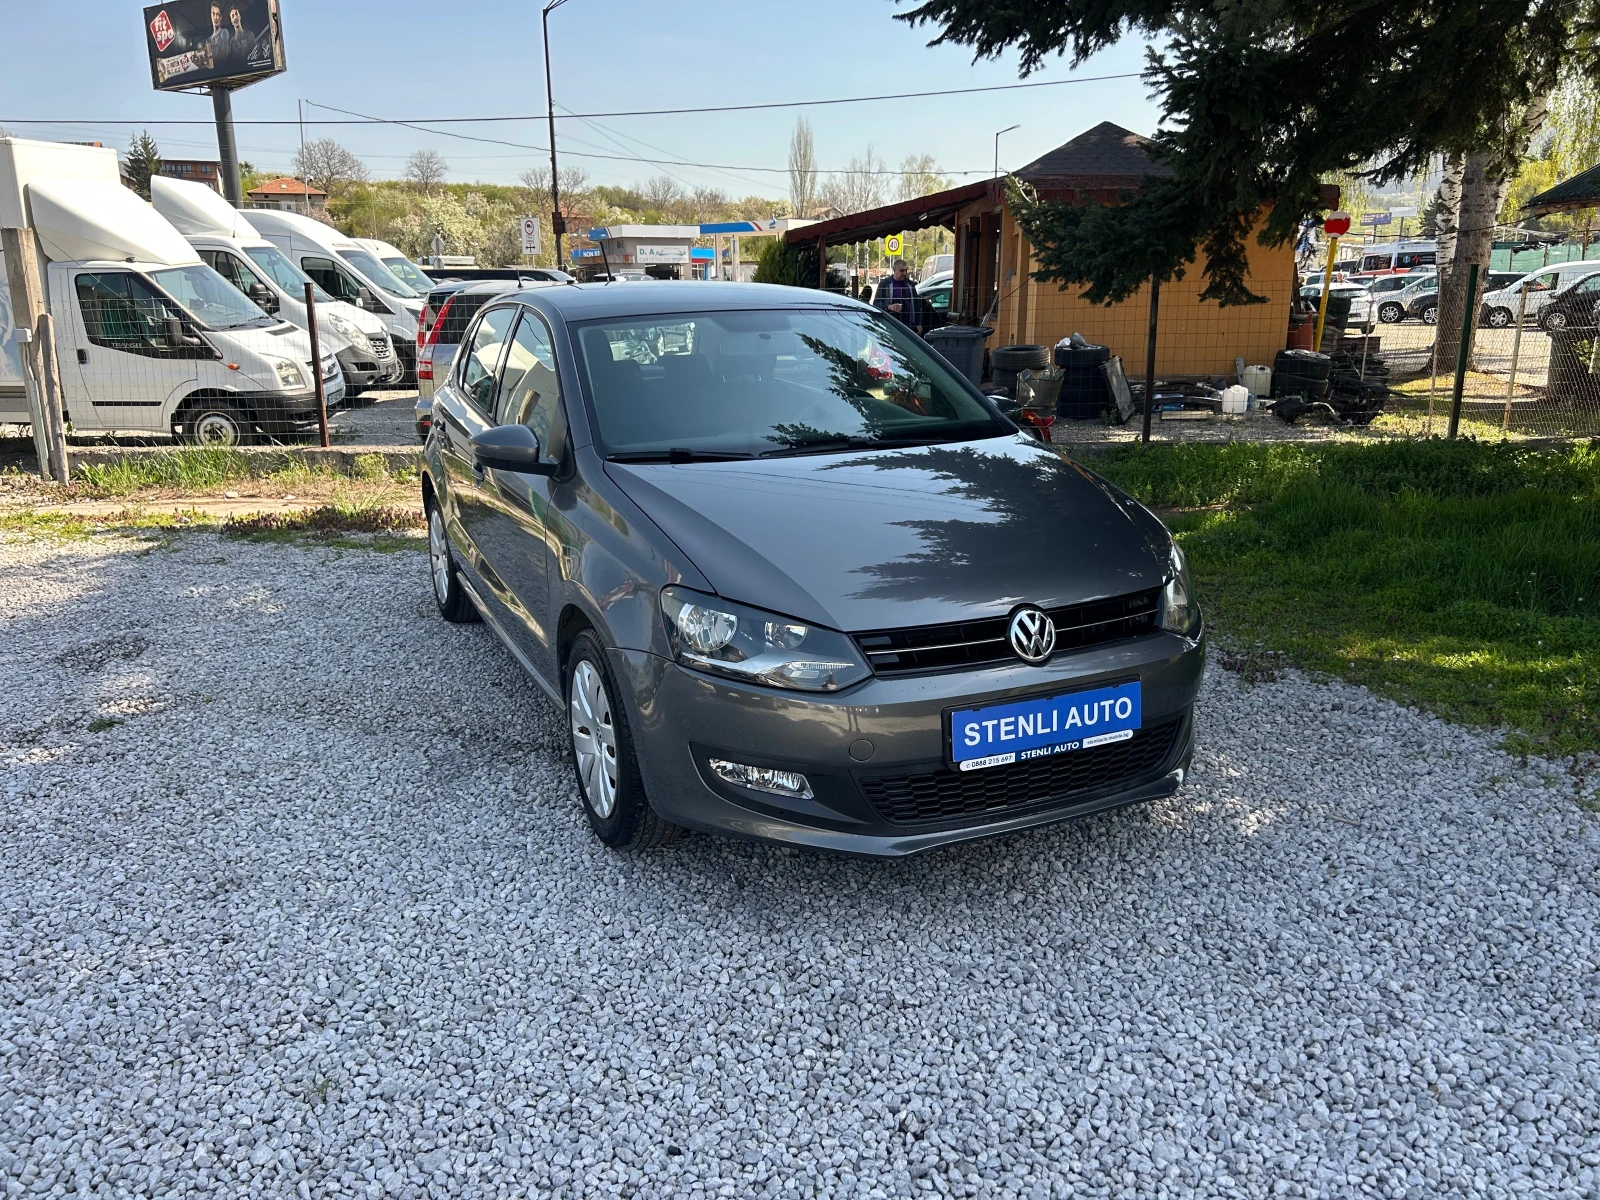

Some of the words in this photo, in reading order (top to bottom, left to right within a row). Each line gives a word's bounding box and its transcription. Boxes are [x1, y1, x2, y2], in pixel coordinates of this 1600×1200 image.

[155, 17, 167, 31] fit
[157, 29, 175, 44] spo
[963, 709, 1058, 746] STENLI
[1064, 696, 1132, 729] AUTO
[1020, 747, 1051, 759] STENLI
[1053, 741, 1080, 754] AUTO
[971, 760, 987, 768] 0888
[988, 757, 1000, 765] 215
[1000, 755, 1013, 763] 697
